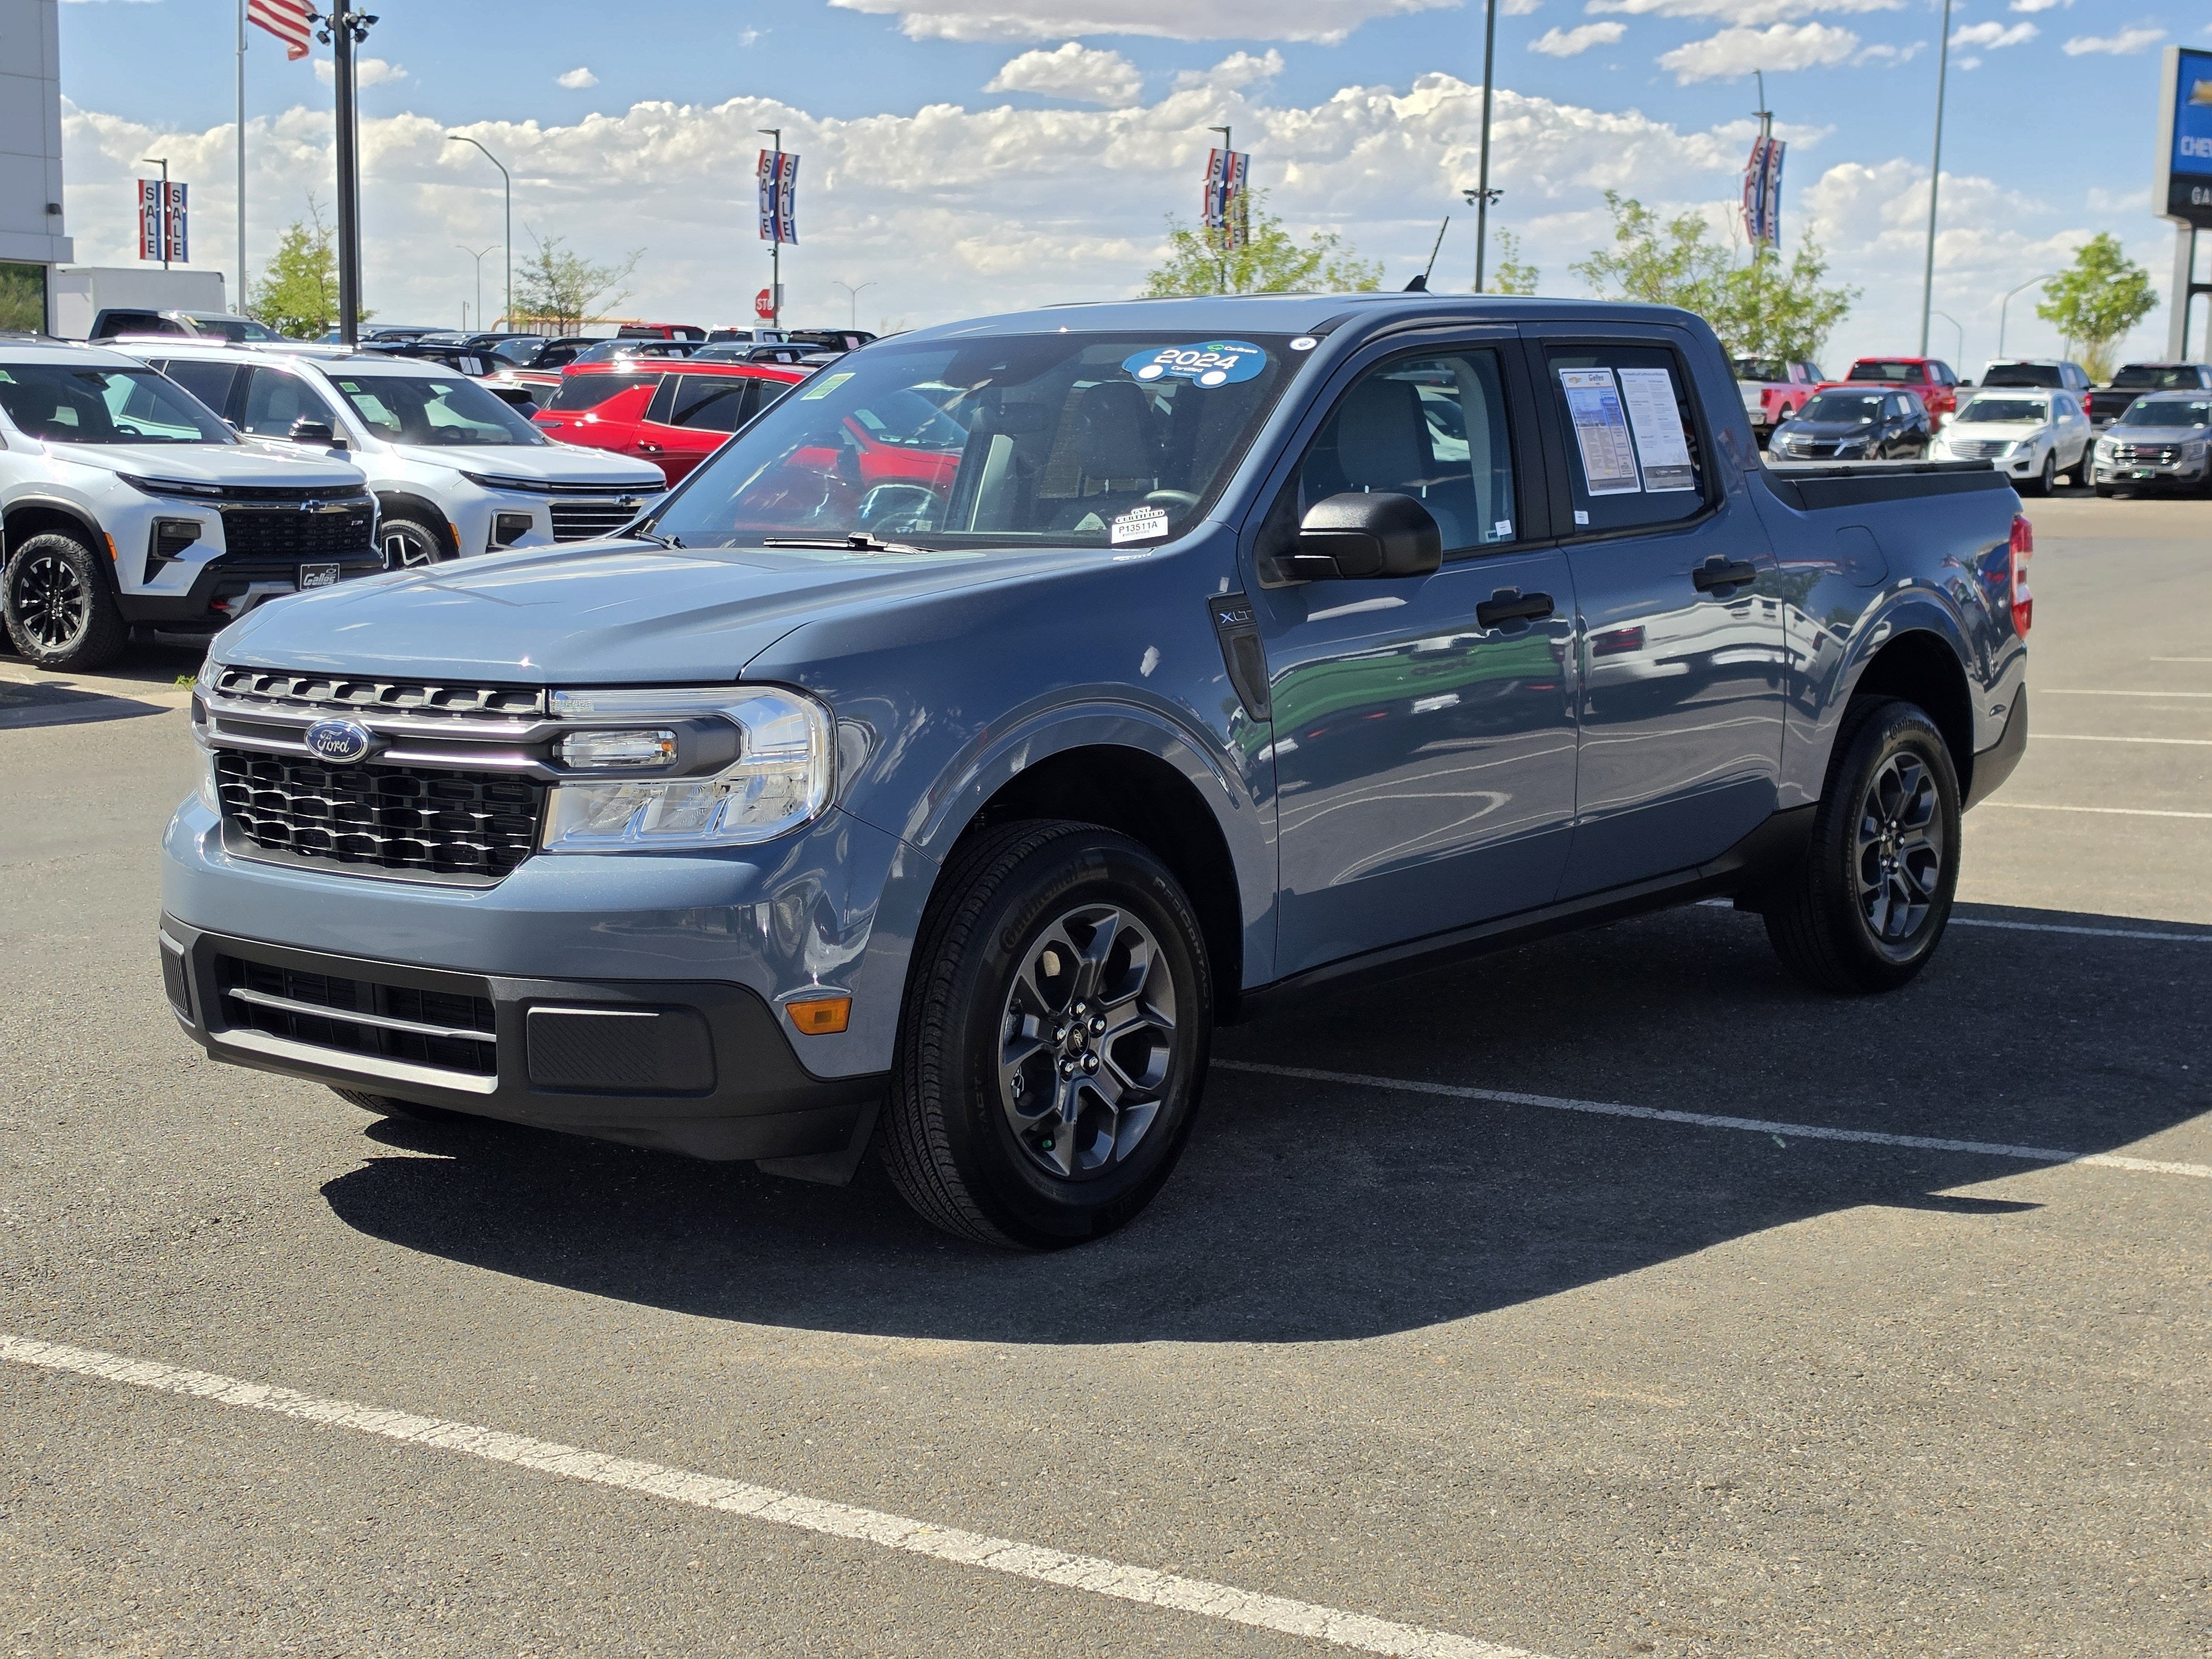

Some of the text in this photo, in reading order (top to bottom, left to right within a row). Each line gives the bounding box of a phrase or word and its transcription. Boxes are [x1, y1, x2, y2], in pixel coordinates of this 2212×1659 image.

[2180, 135, 2212, 158] CHE
[761, 158, 771, 233] SALE
[781, 161, 792, 237] SALE
[1211, 158, 1221, 229] SAL
[145, 187, 155, 254] SALE
[172, 190, 181, 256] SALE
[757, 299, 774, 311] STO
[1154, 349, 1240, 369] 2024
[1117, 511, 1163, 523] CERTIFIED
[1119, 521, 1157, 533] P13511A
[303, 573, 336, 586] Galles
[1219, 609, 1253, 624] XLT
[1889, 717, 1931, 740] Continental
[317, 729, 351, 753] Ford
